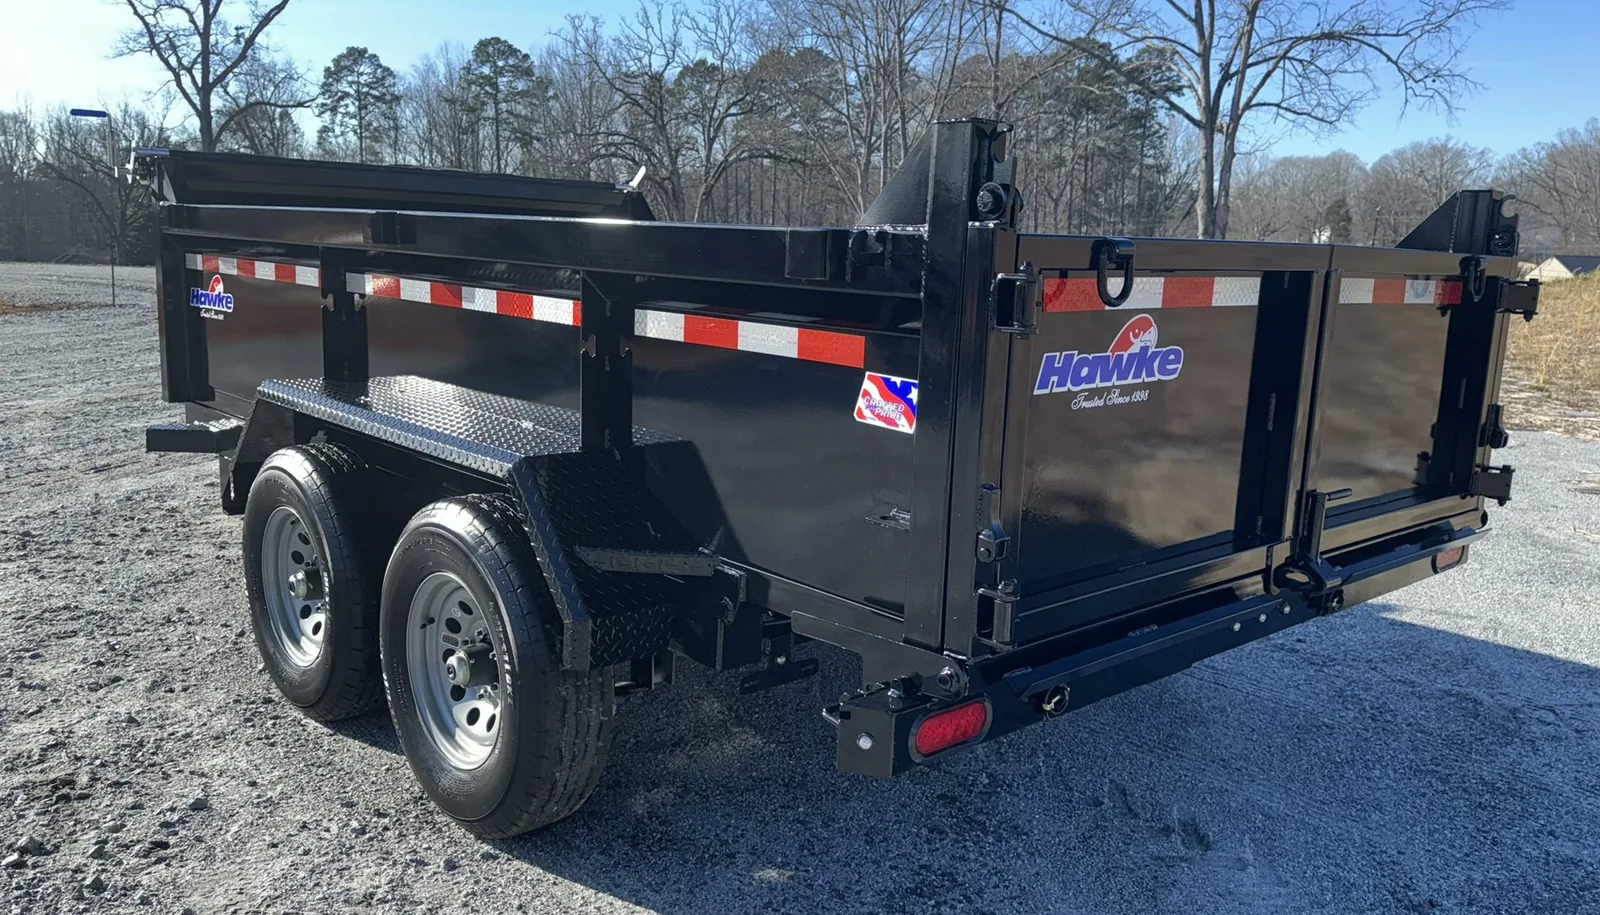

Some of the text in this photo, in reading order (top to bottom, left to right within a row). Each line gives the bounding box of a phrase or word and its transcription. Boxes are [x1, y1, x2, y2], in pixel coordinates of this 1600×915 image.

[190, 287, 234, 312] Hawke
[1033, 345, 1184, 395] Hawke
[1071, 388, 1150, 410] Trusted Since 1998
[875, 407, 902, 420] PRIDE
